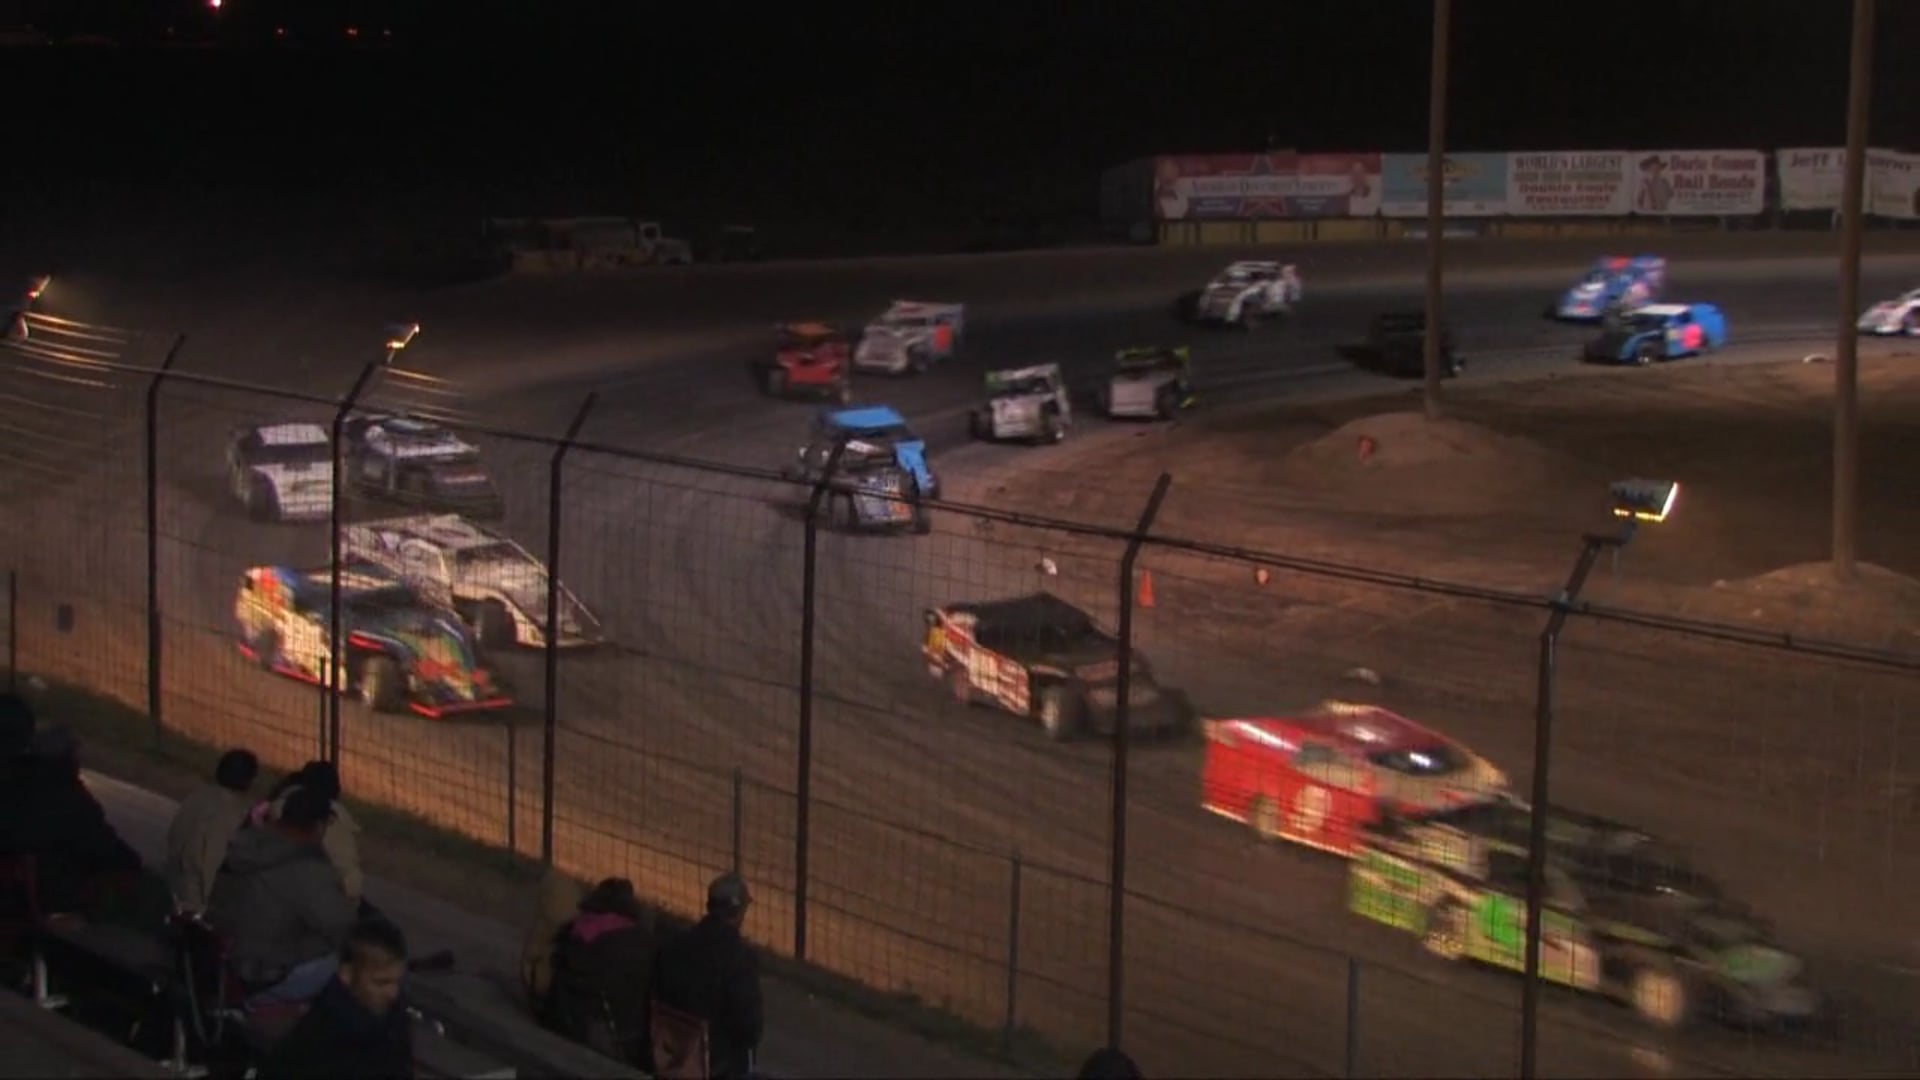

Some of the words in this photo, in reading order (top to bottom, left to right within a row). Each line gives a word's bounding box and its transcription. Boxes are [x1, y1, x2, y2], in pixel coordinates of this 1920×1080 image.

[1516, 156, 1568, 169] WORLD'S
[1571, 156, 1622, 169] LARGEST
[1674, 173, 1704, 189] Bail
[1709, 173, 1755, 189] Bonds
